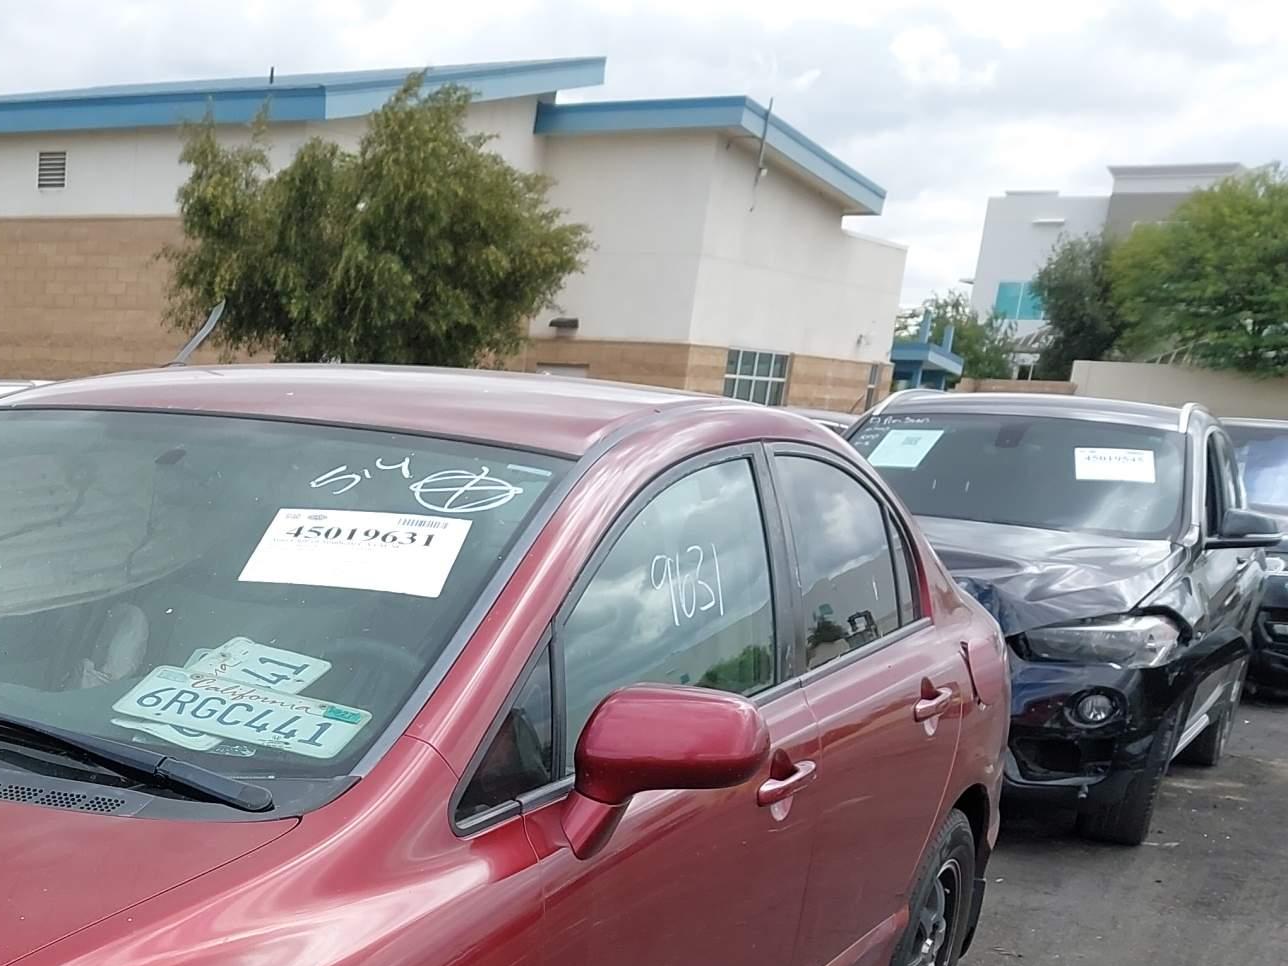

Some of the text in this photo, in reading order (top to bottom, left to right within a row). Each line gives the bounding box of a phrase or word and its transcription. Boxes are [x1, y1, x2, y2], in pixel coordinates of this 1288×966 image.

[285, 525, 436, 547] 45019631
[651, 543, 724, 626] 9631
[136, 687, 333, 747] 6RGC441
[191, 678, 323, 717] California
